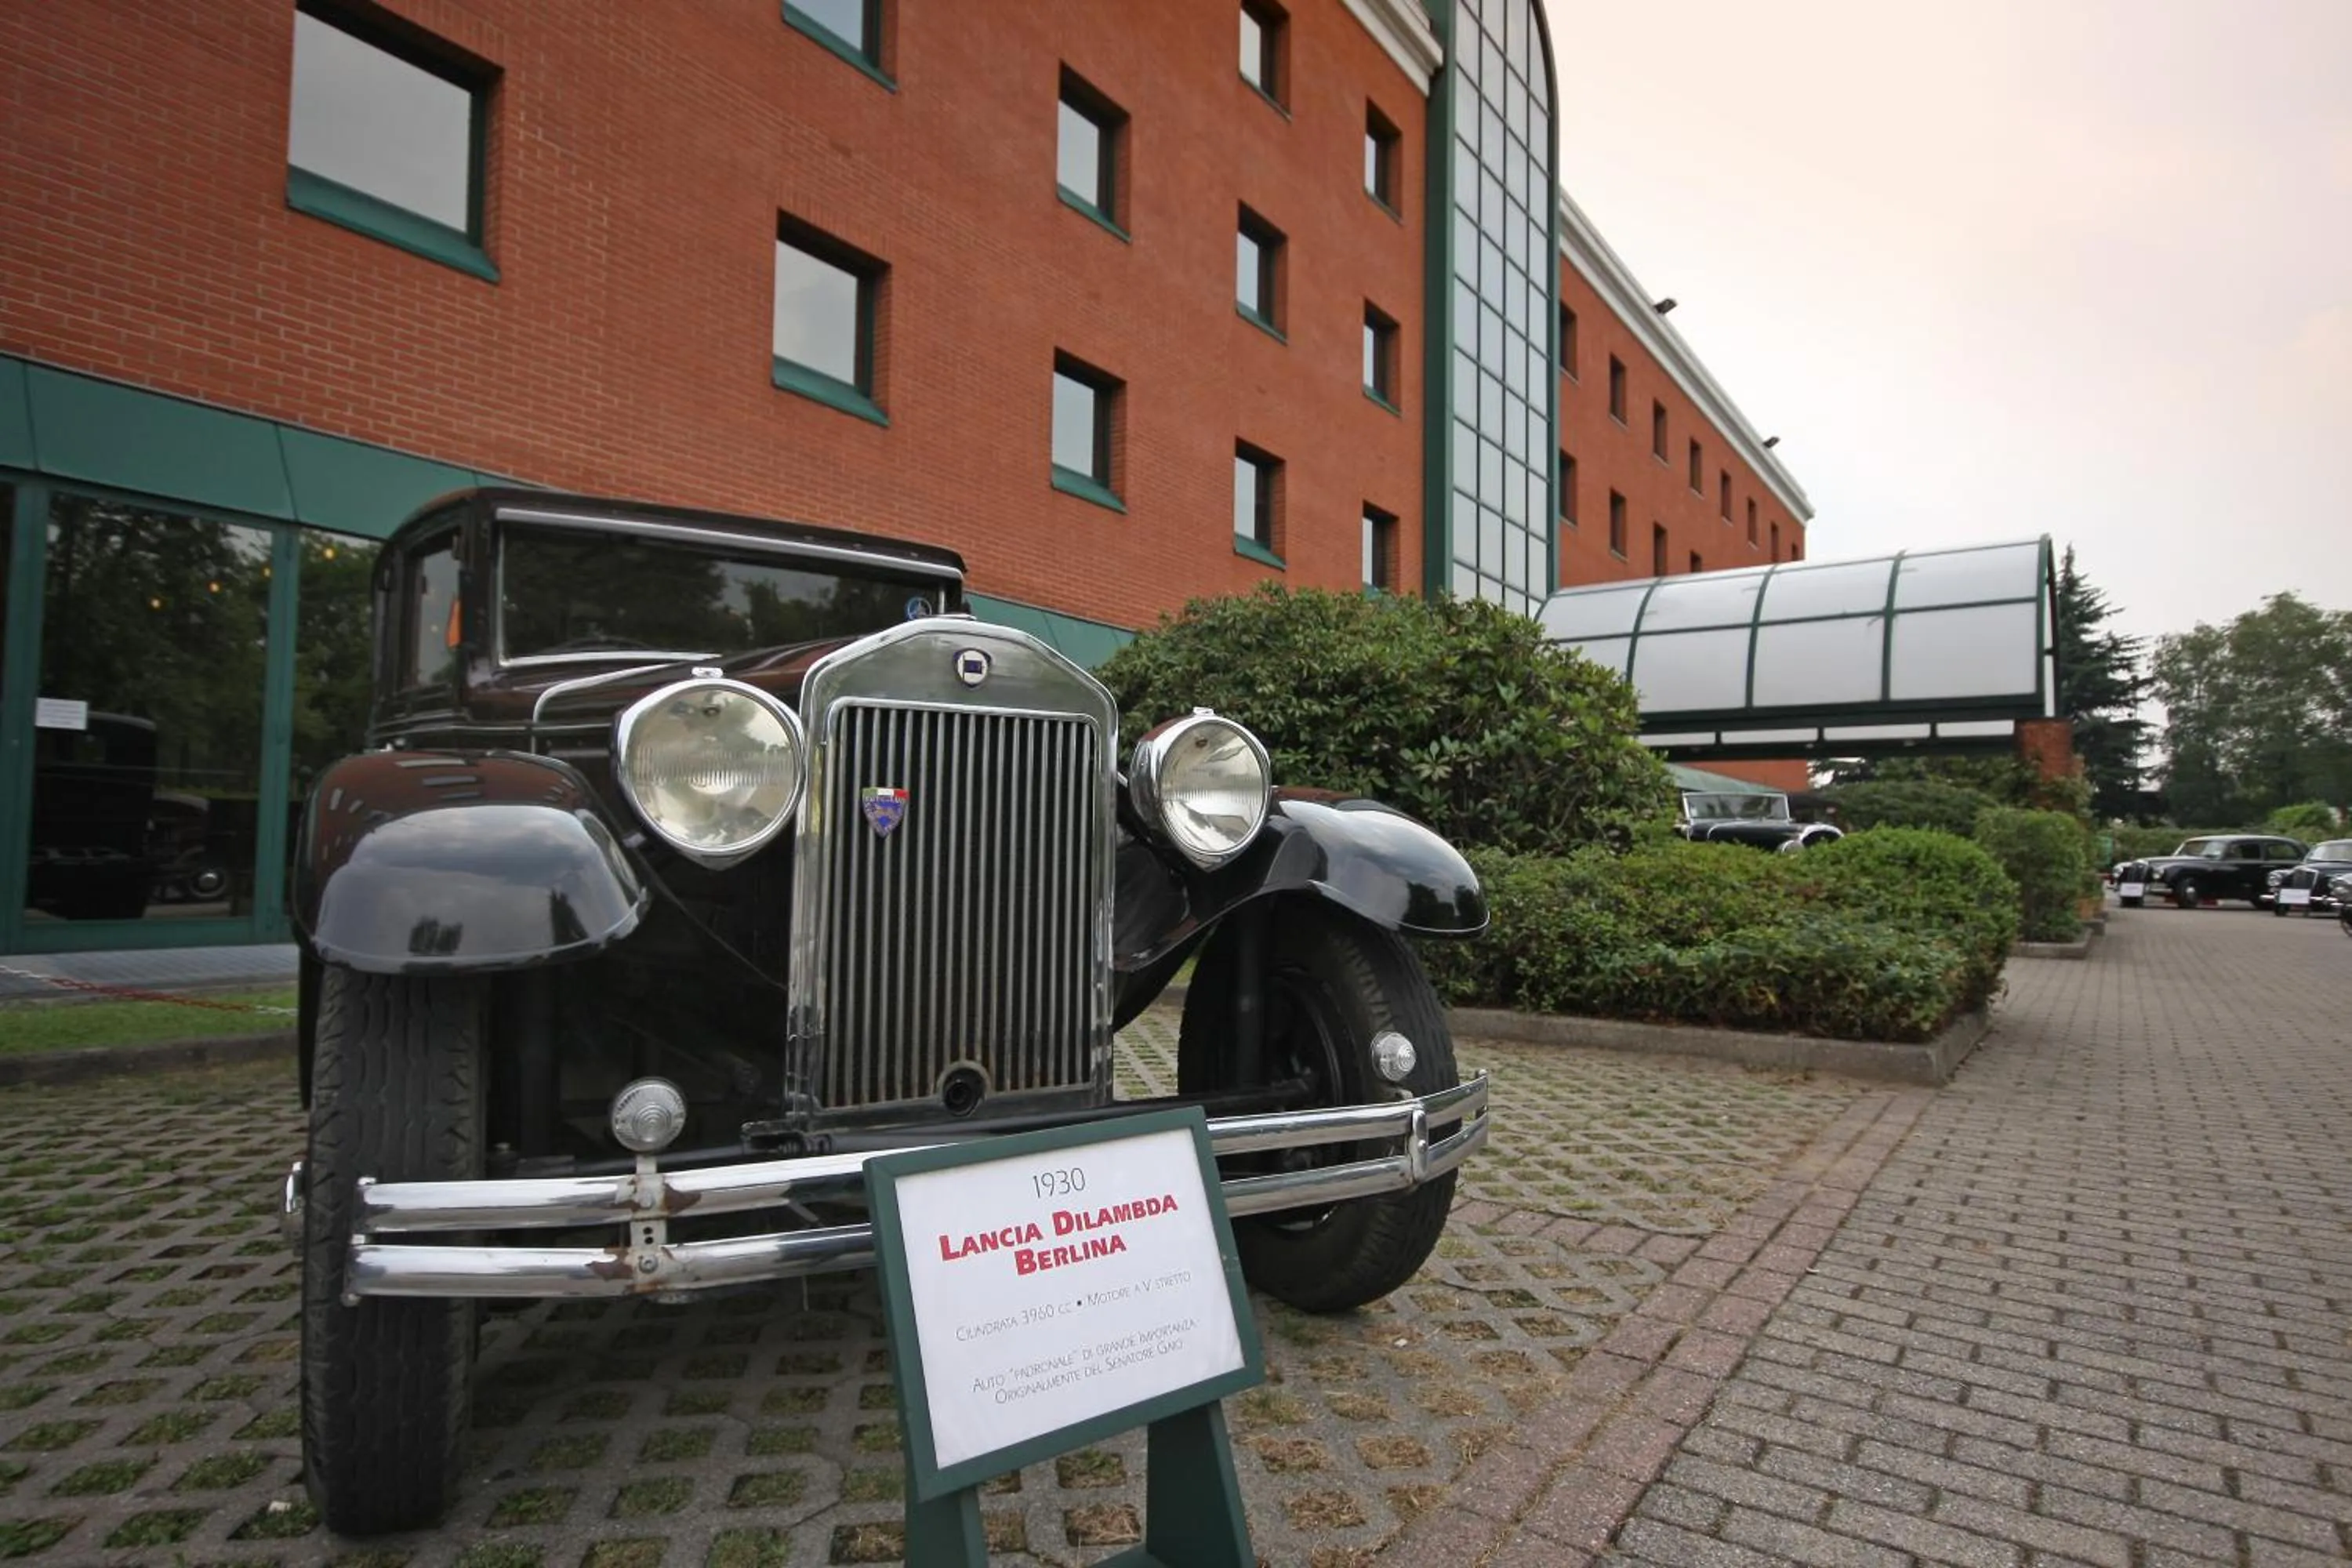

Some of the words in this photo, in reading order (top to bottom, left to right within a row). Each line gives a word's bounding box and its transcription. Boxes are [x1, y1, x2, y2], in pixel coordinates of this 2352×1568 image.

[1033, 1167, 1085, 1198] 1930
[938, 1222, 1044, 1261] LANCIA
[1052, 1194, 1178, 1236] DILAMBDA
[1014, 1234, 1127, 1276] BERLINA
[1087, 1286, 1130, 1306] MOTORE
[1142, 1279, 1152, 1292] V
[1155, 1271, 1191, 1290] STRETTO
[972, 1374, 1005, 1393] AUTO
[1095, 1334, 1136, 1356] GRANDE
[1105, 1347, 1155, 1372] SENATORE
